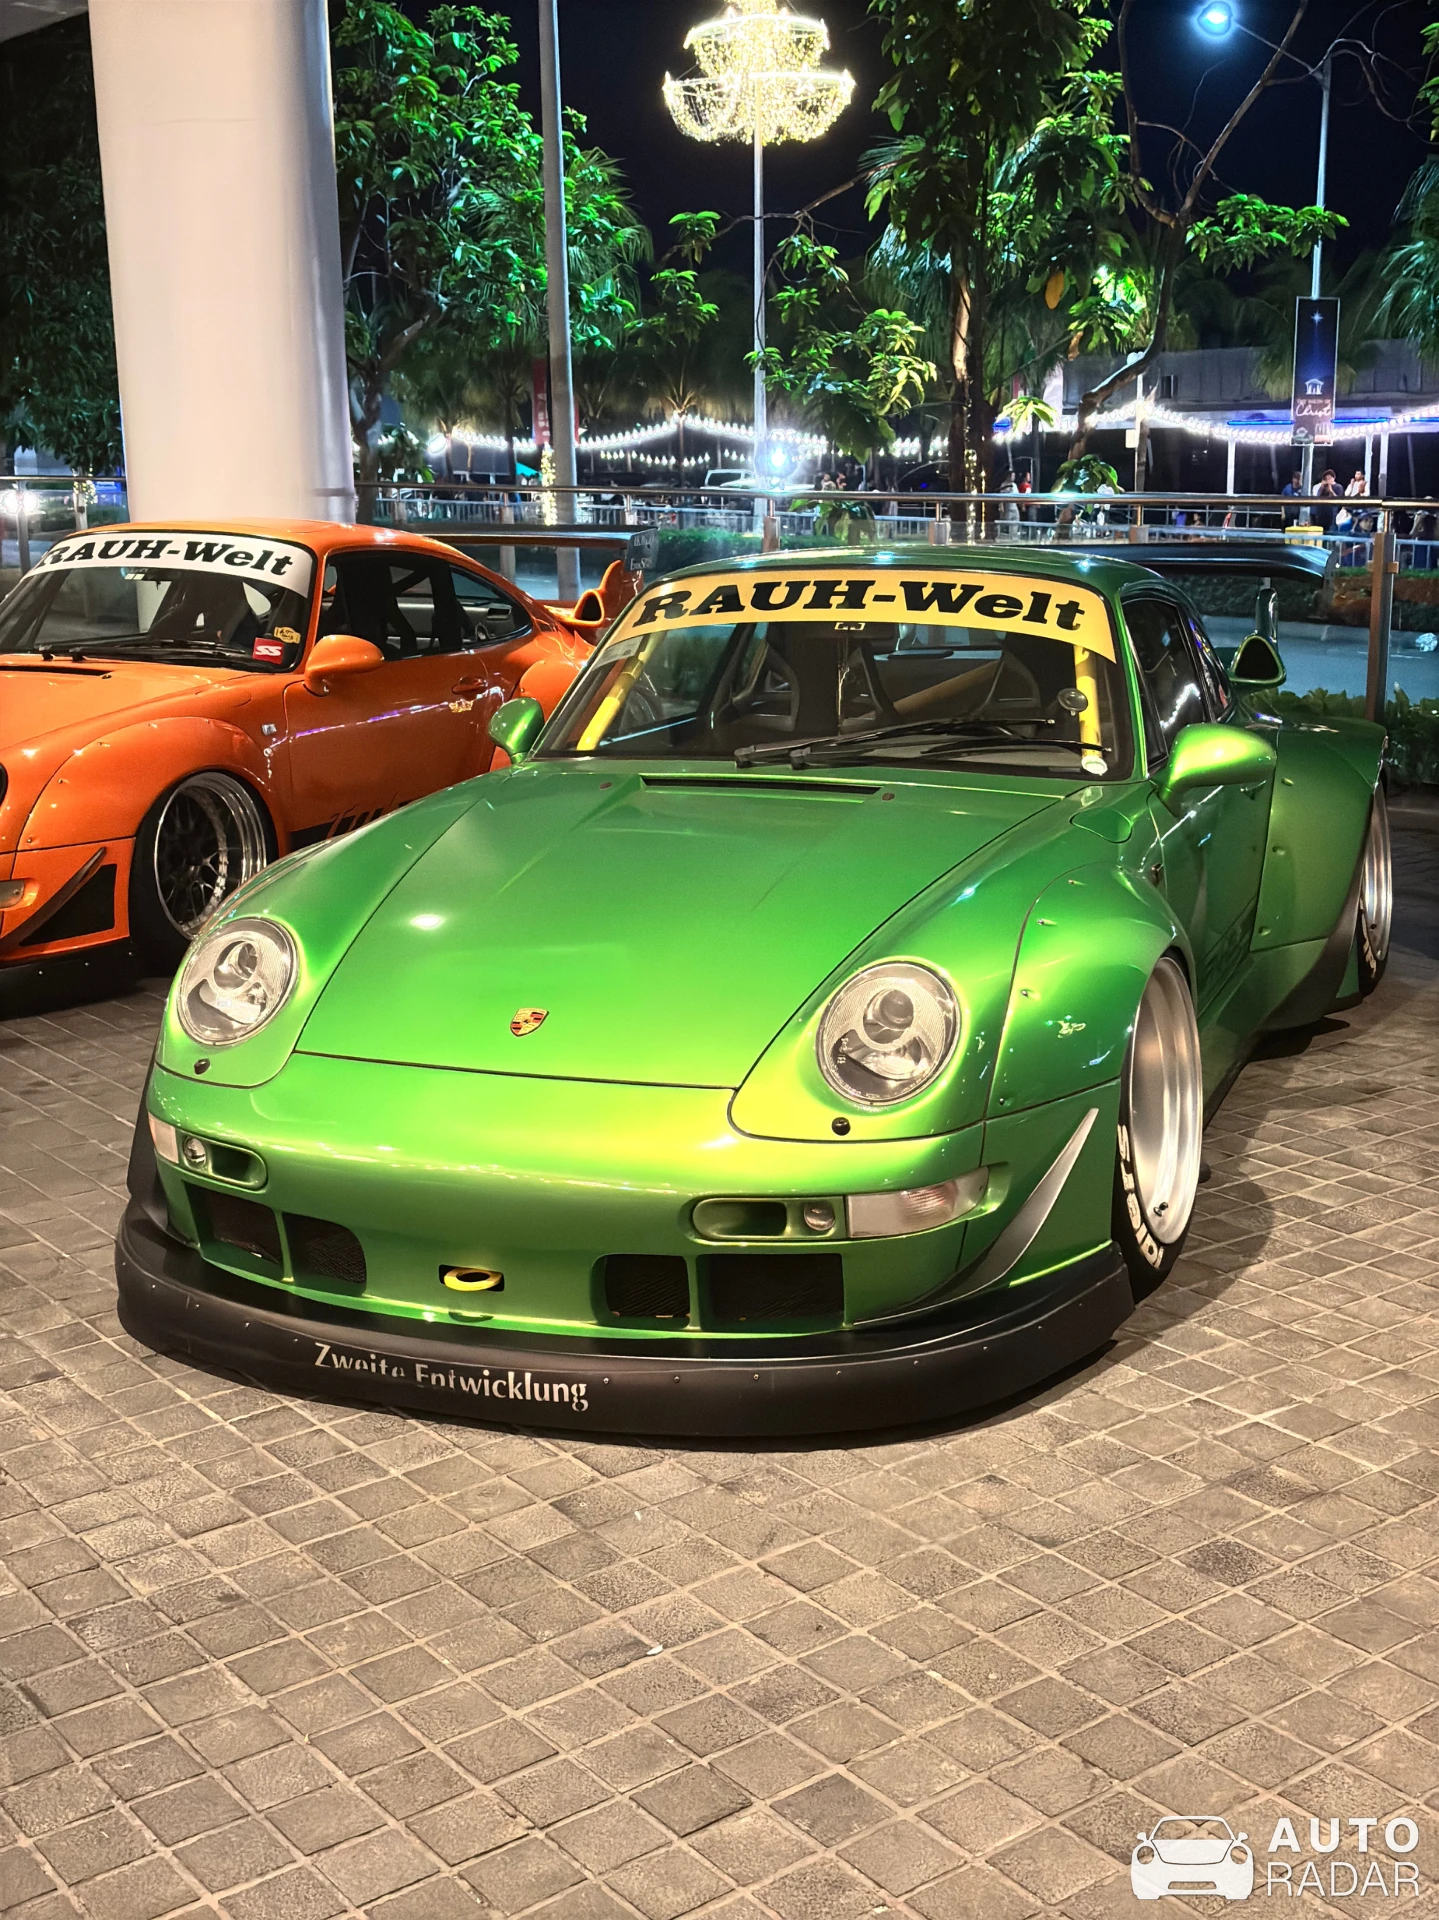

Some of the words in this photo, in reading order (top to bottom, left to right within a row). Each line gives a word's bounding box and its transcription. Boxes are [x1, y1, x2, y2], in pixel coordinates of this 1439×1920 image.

[35, 539, 295, 576] RAUH-Welt
[632, 579, 1086, 631] RAUH-Welt
[314, 1341, 406, 1378] Zweite
[415, 1362, 589, 1412] Entwicklung
